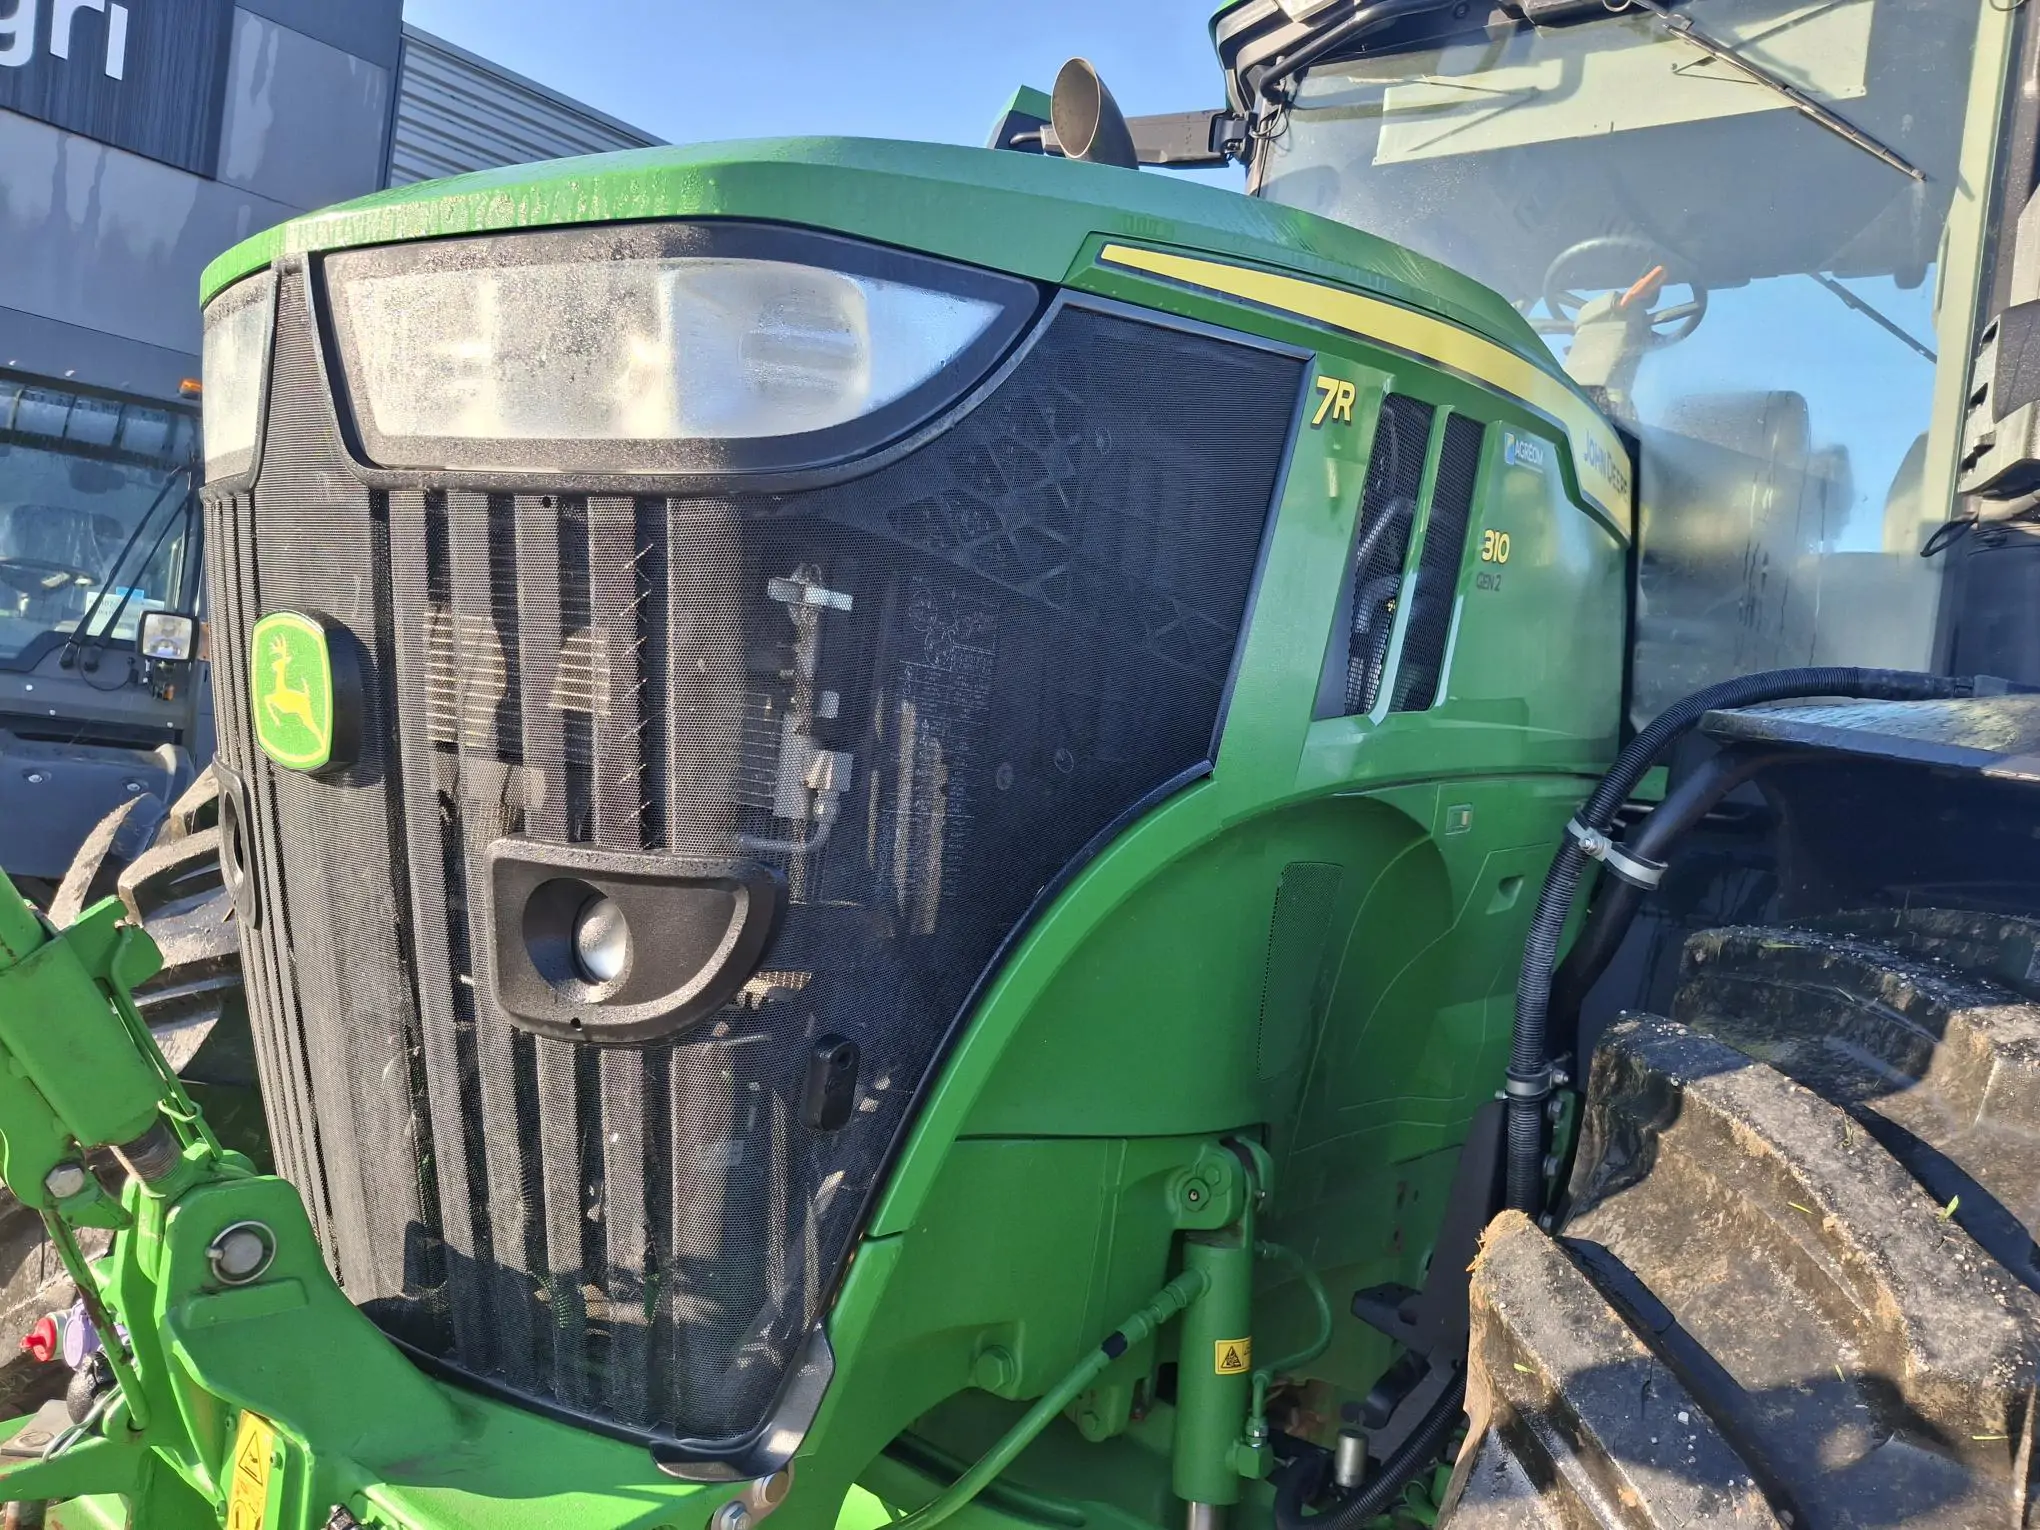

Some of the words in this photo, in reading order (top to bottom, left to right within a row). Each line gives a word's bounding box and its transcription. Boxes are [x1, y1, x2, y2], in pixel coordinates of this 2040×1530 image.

[1311, 375, 1356, 426] 7R
[1481, 528, 1510, 565] 310
[1476, 571, 1495, 591] GEN
[1494, 574, 1502, 592] 2
